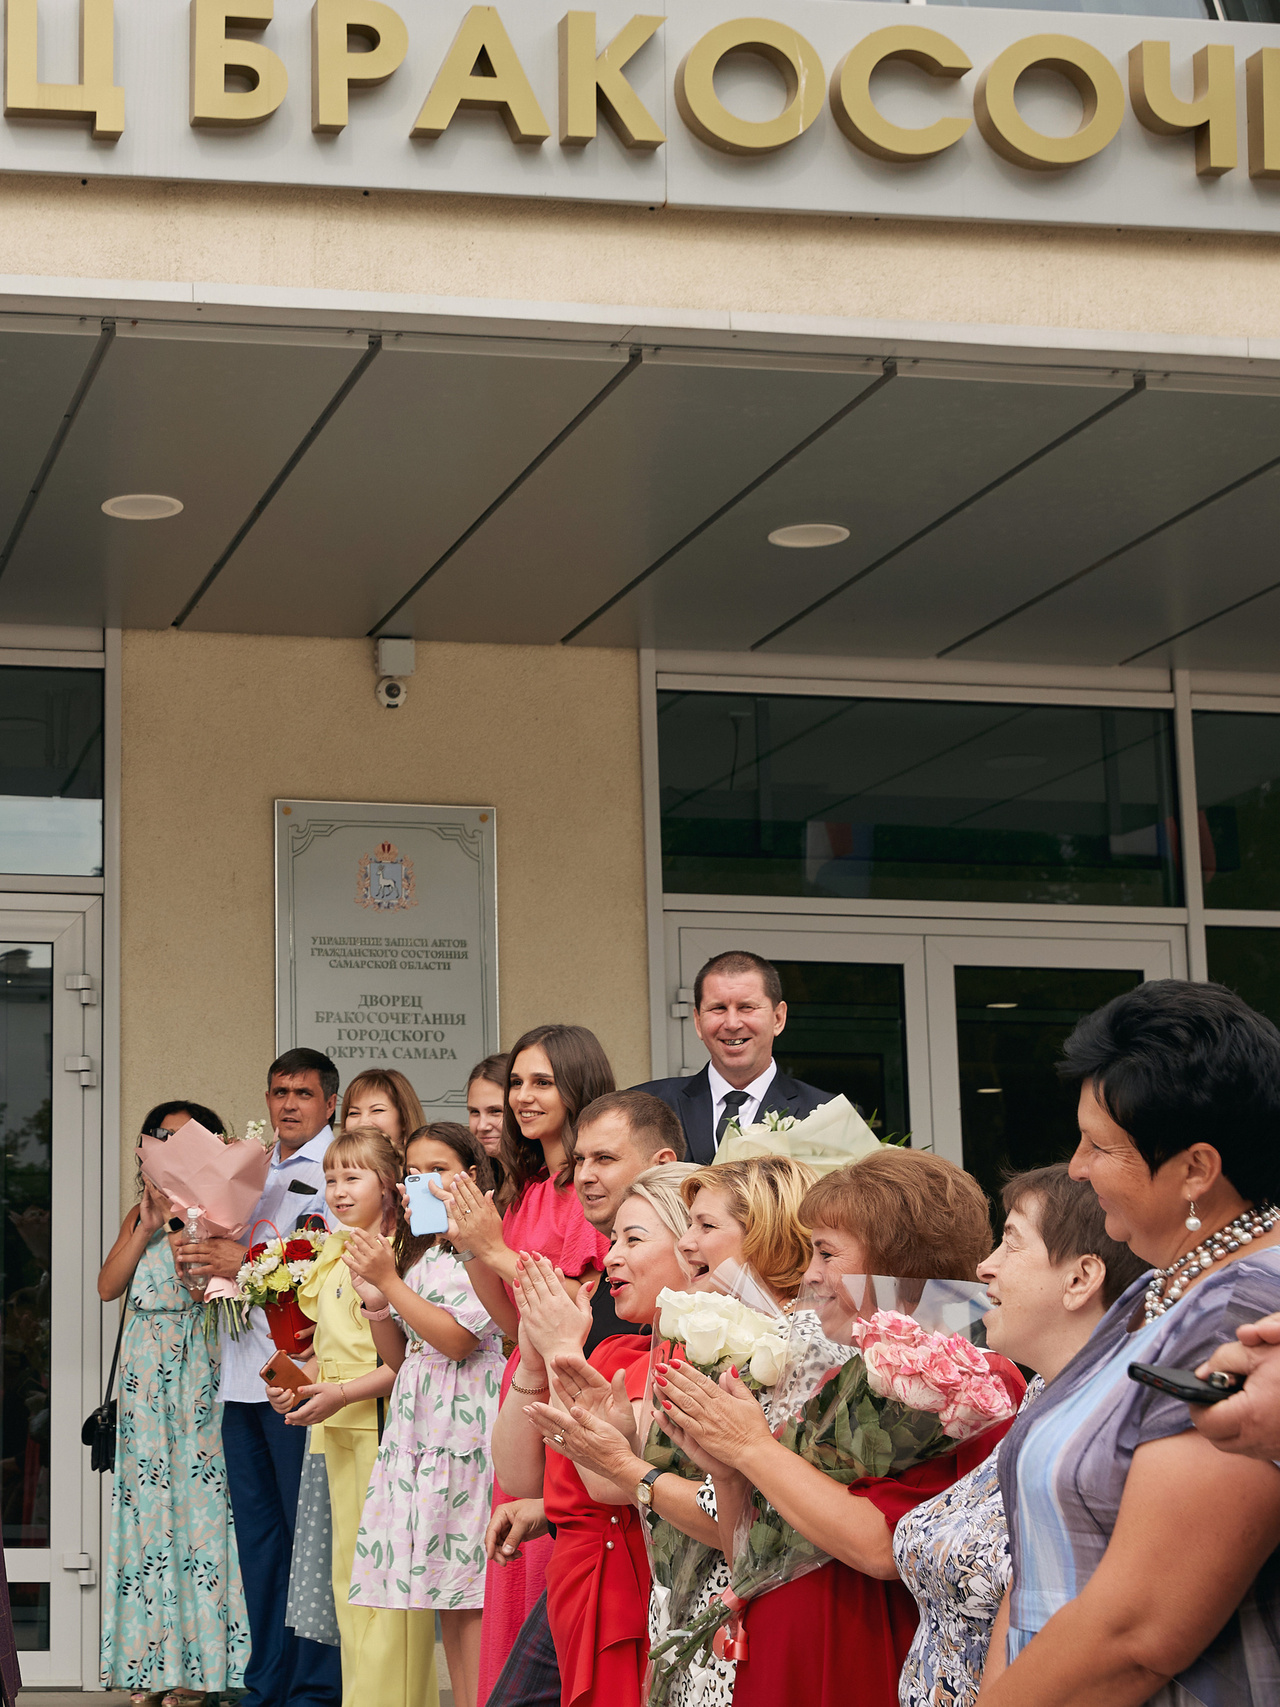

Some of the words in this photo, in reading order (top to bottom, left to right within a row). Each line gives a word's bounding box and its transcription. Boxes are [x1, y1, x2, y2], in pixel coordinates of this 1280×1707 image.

[384, 937, 429, 948] ЗАПИСИ
[431, 939, 467, 948] АКТОВ
[310, 948, 399, 959] ГРАЖДАНСКОГО
[401, 949, 469, 960] СОСТОЯНИЯ
[328, 959, 397, 970] САМАРСКОЙ
[400, 961, 451, 970] ОБЛАСТИ
[358, 995, 423, 1009] ДВОРЕЦ
[315, 1011, 466, 1025] БРАКОСОЧЕТАНИЯ
[338, 1029, 445, 1043] ГОРОДСКОГО
[326, 1046, 388, 1059] ОКРУГА
[392, 1049, 457, 1060] САМАРА
